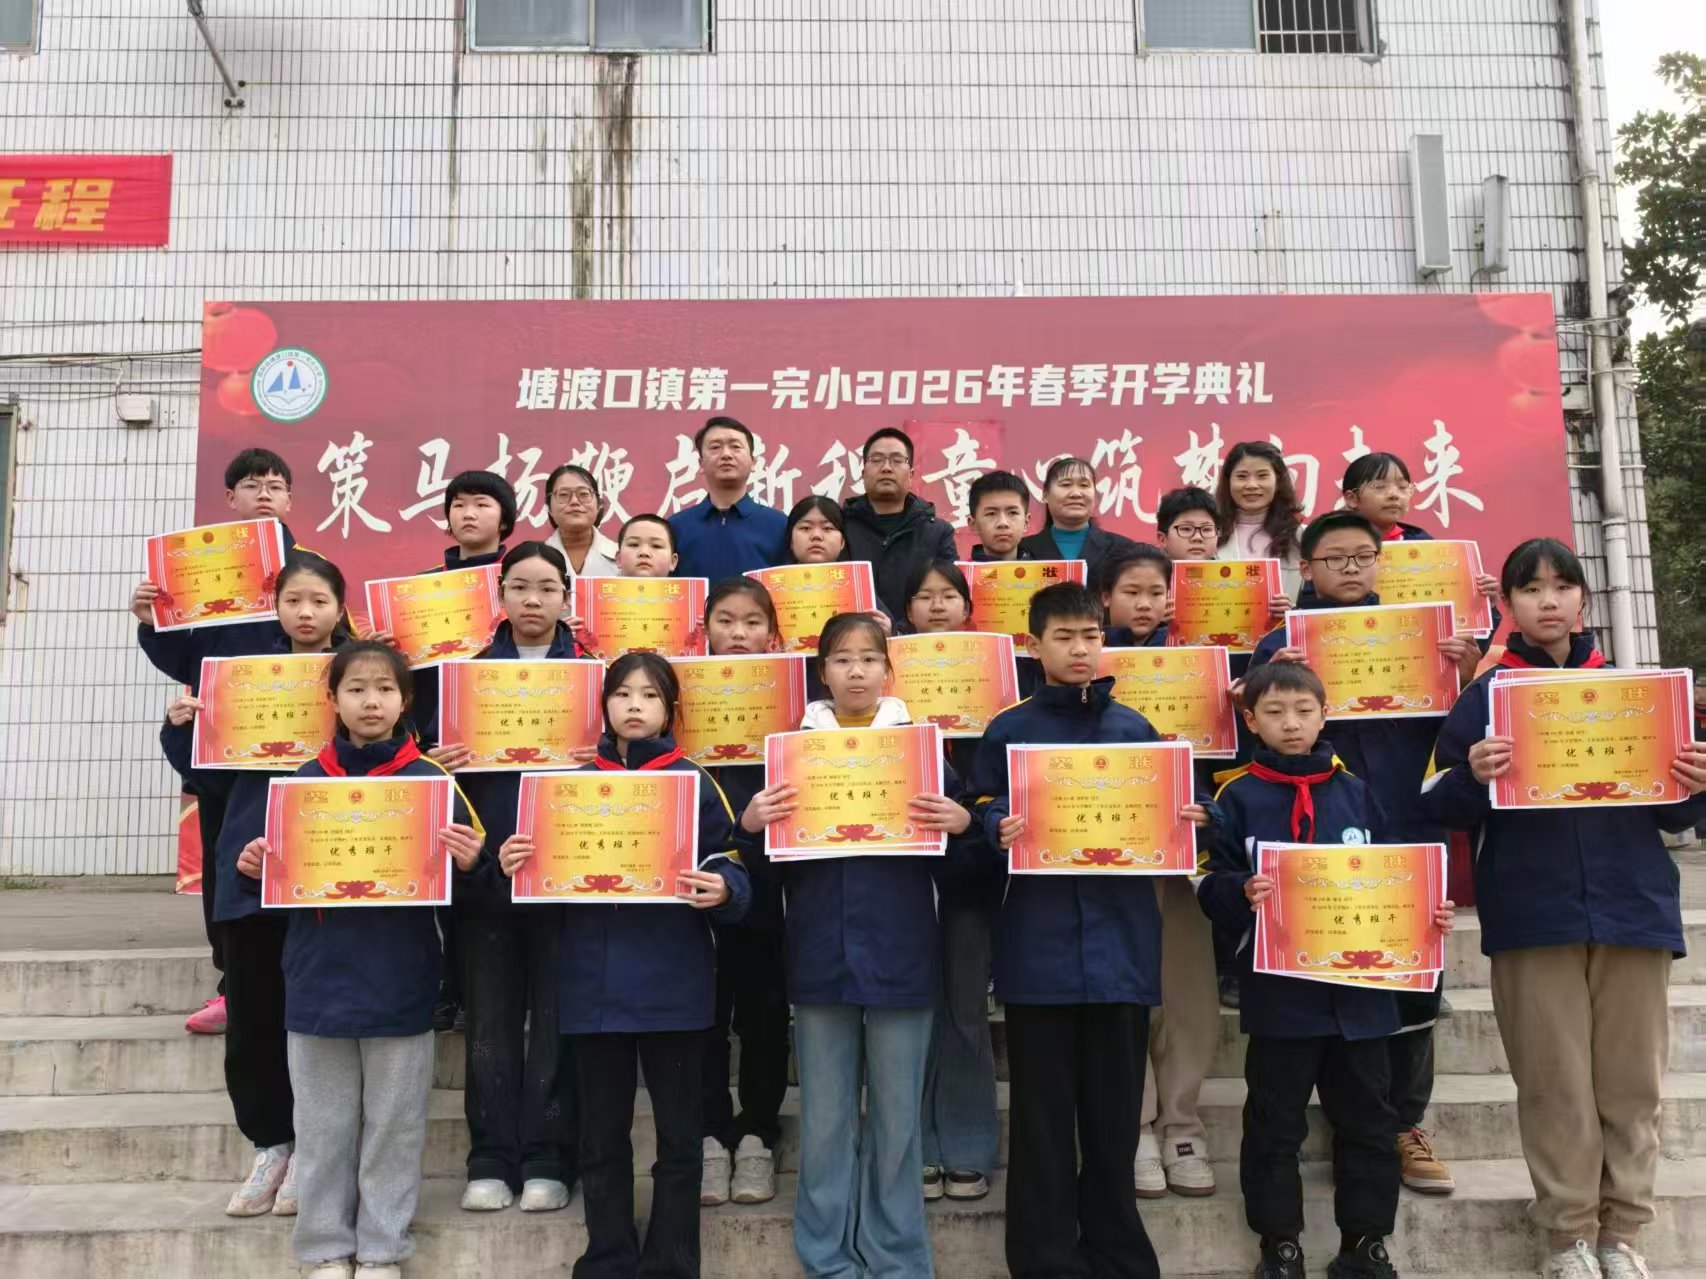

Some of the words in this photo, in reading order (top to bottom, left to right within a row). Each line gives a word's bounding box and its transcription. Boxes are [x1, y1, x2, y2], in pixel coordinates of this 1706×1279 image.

[516, 361, 1275, 412] 塘渡口镇第一完小2026年春季开学典礼
[1351, 665, 1409, 675] 优秀班干
[922, 687, 974, 695] 优秀班干
[1138, 703, 1191, 713] 优秀班干
[256, 710, 309, 720] 优秀班干
[708, 714, 760, 724] 优秀班干
[500, 718, 557, 727] 优秀班干
[1566, 746, 1636, 758] 优秀班干
[830, 790, 889, 801] 优秀班干
[1076, 811, 1139, 823] 优秀班干
[579, 839, 641, 850] 优秀班干
[330, 845, 393, 857] 优秀班干
[1334, 913, 1397, 925] 优秀班干
